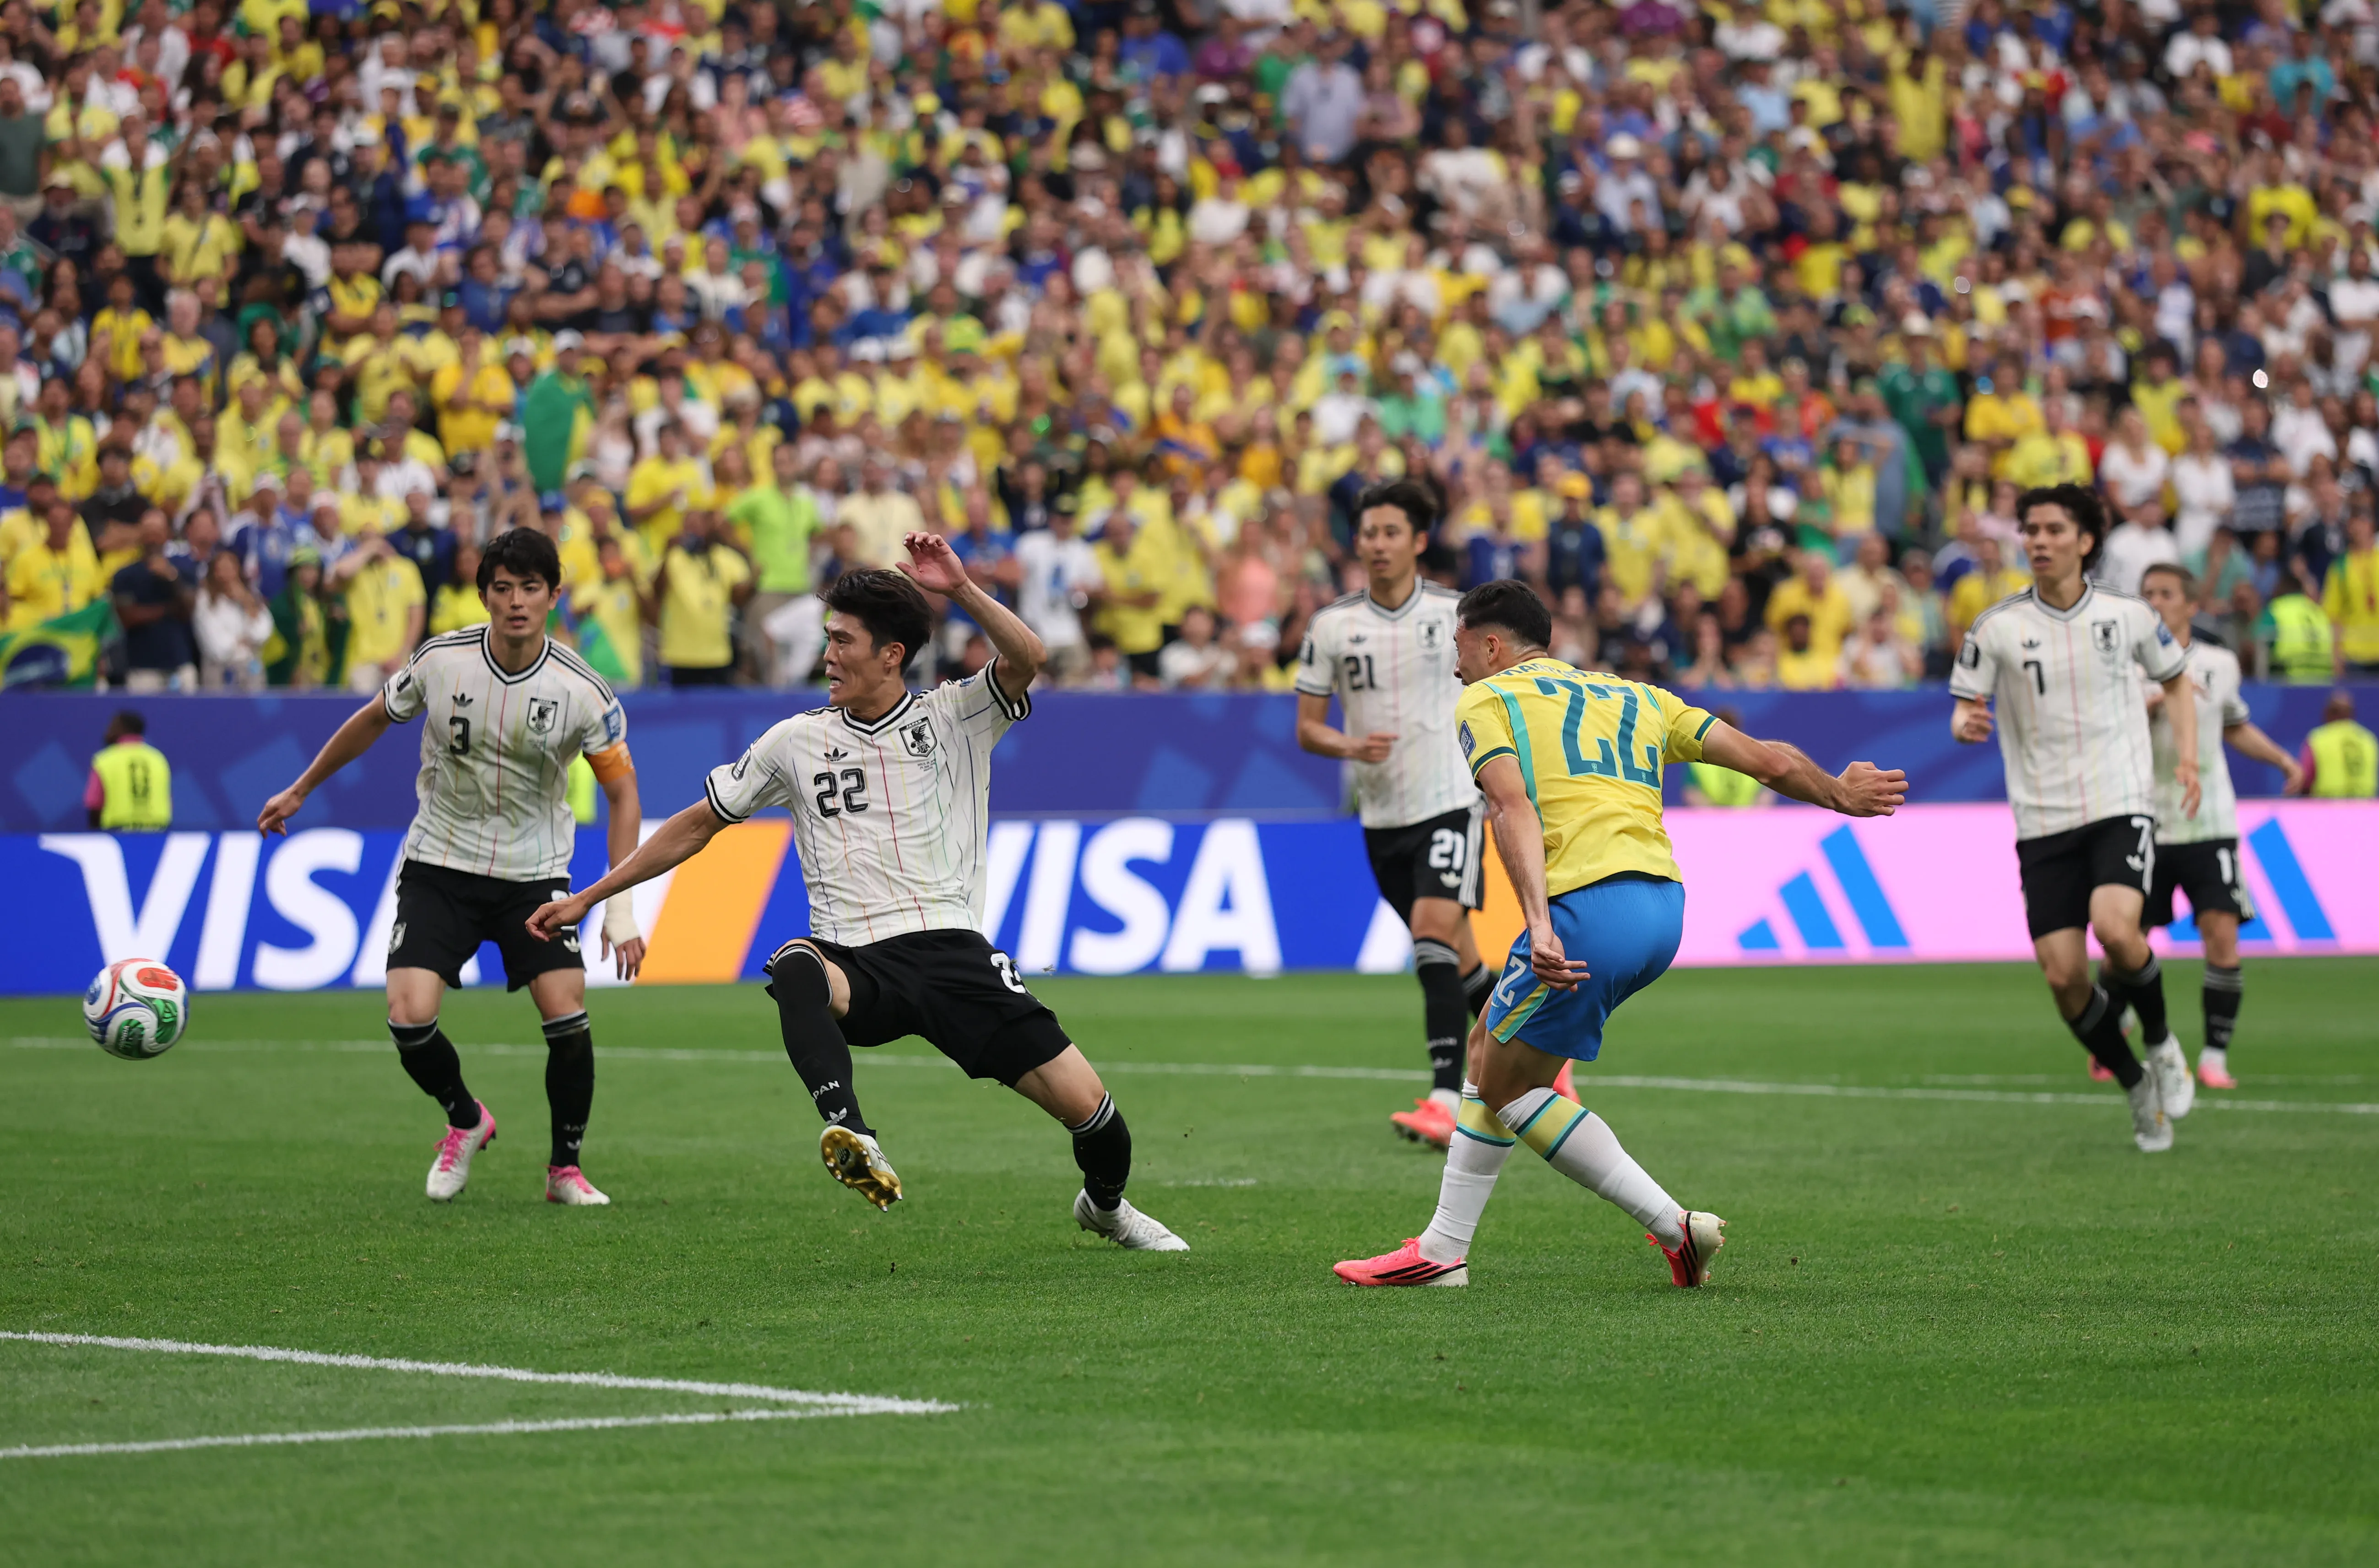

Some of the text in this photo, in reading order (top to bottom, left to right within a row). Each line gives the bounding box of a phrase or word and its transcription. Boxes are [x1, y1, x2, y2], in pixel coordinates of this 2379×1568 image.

[1344, 655, 1375, 691] 21
[2024, 660, 2045, 695] 7
[450, 716, 470, 755] 3
[906, 719, 922, 729] JAPAN
[1534, 676, 1661, 790] 22
[813, 768, 870, 819] 22
[1428, 828, 1466, 870] 21
[2130, 816, 2152, 854] 7
[990, 952, 1030, 993] 2
[812, 1080, 840, 1104] PAN
